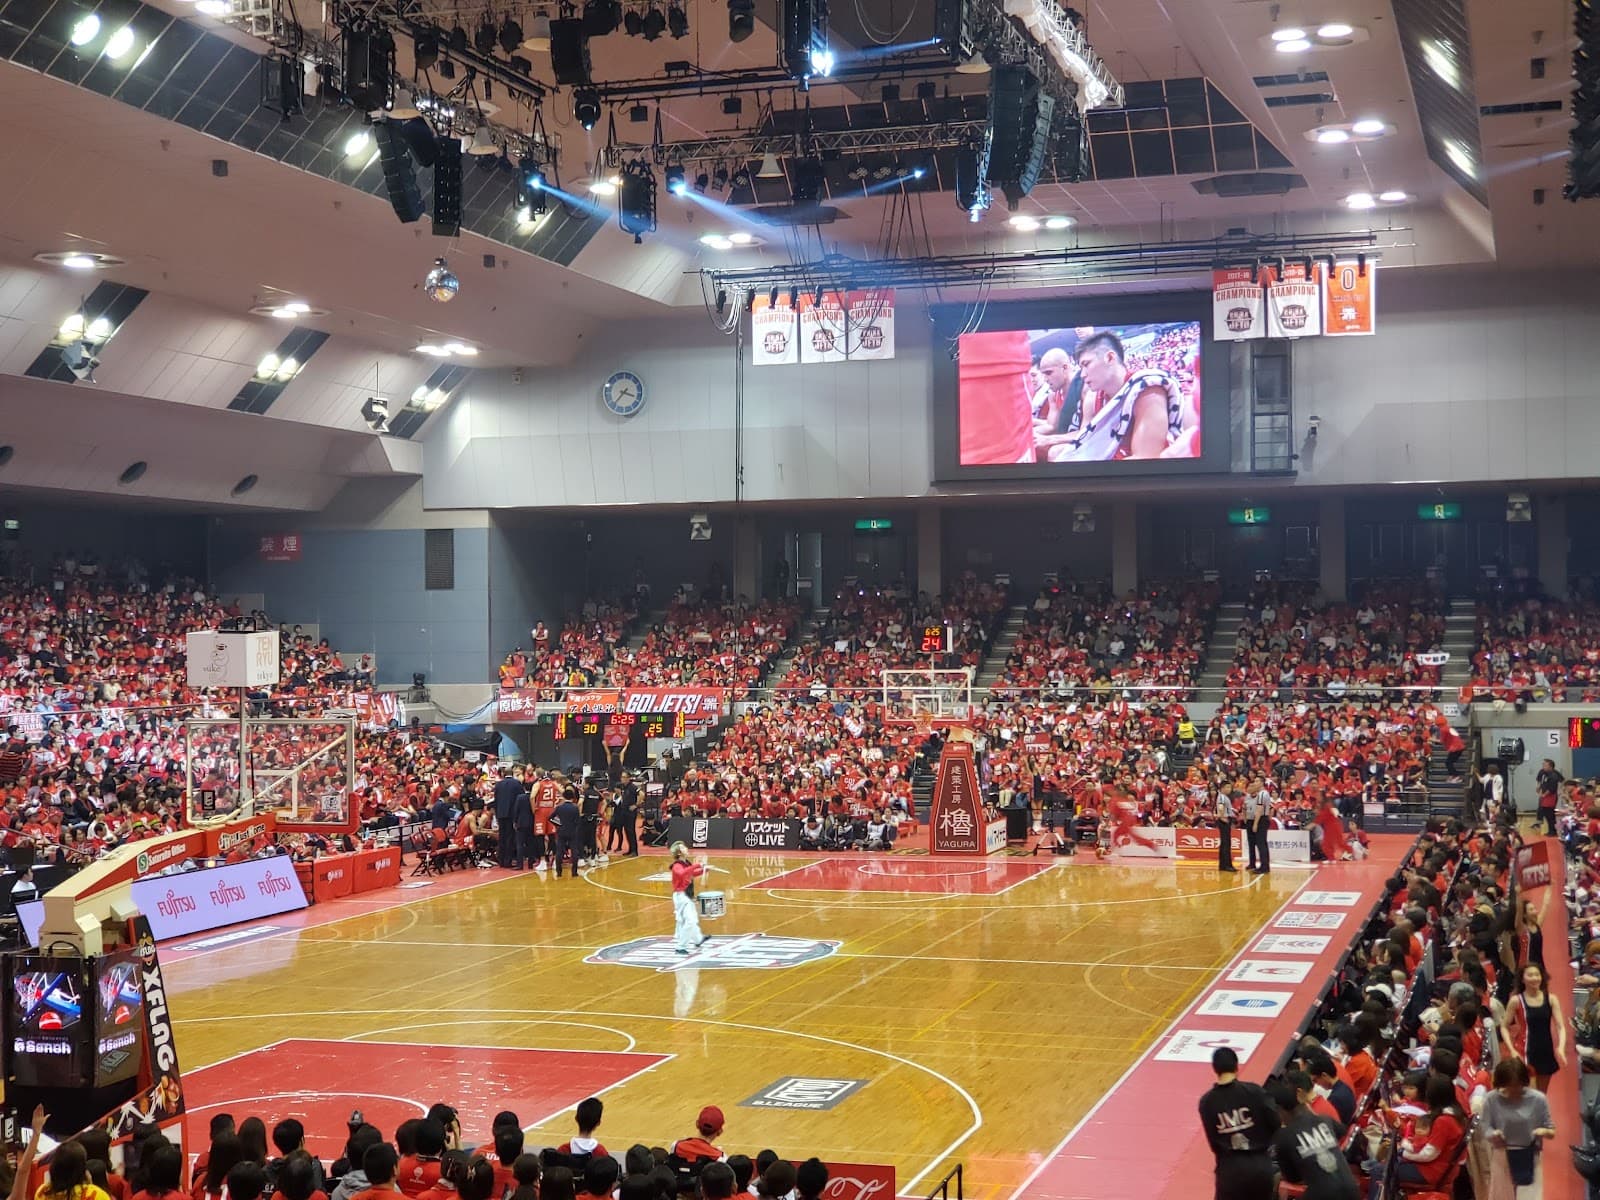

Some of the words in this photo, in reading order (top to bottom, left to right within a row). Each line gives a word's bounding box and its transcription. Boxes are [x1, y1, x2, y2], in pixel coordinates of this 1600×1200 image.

[1341, 268, 1355, 291] 0
[257, 636, 273, 650] TEN
[922, 637, 940, 651] 24
[256, 651, 273, 666] RYU
[500, 697, 534, 713] 原修太
[653, 695, 702, 713] JETS!
[611, 716, 635, 724] 6:25
[584, 724, 597, 733] 30
[649, 724, 662, 733] 25
[1550, 733, 1559, 745] 5
[543, 789, 553, 800] 21
[743, 822, 790, 833] バスケット
[940, 808, 974, 837] 櫓
[759, 835, 785, 846] LIVE
[257, 870, 291, 898] FUJITSU
[210, 880, 246, 908] FUJITSU
[157, 889, 196, 919] FUJITSU
[142, 966, 175, 1072] XFLAG
[752, 1100, 824, 1108] B.LEAGUE
[1216, 1107, 1252, 1129] JMC
